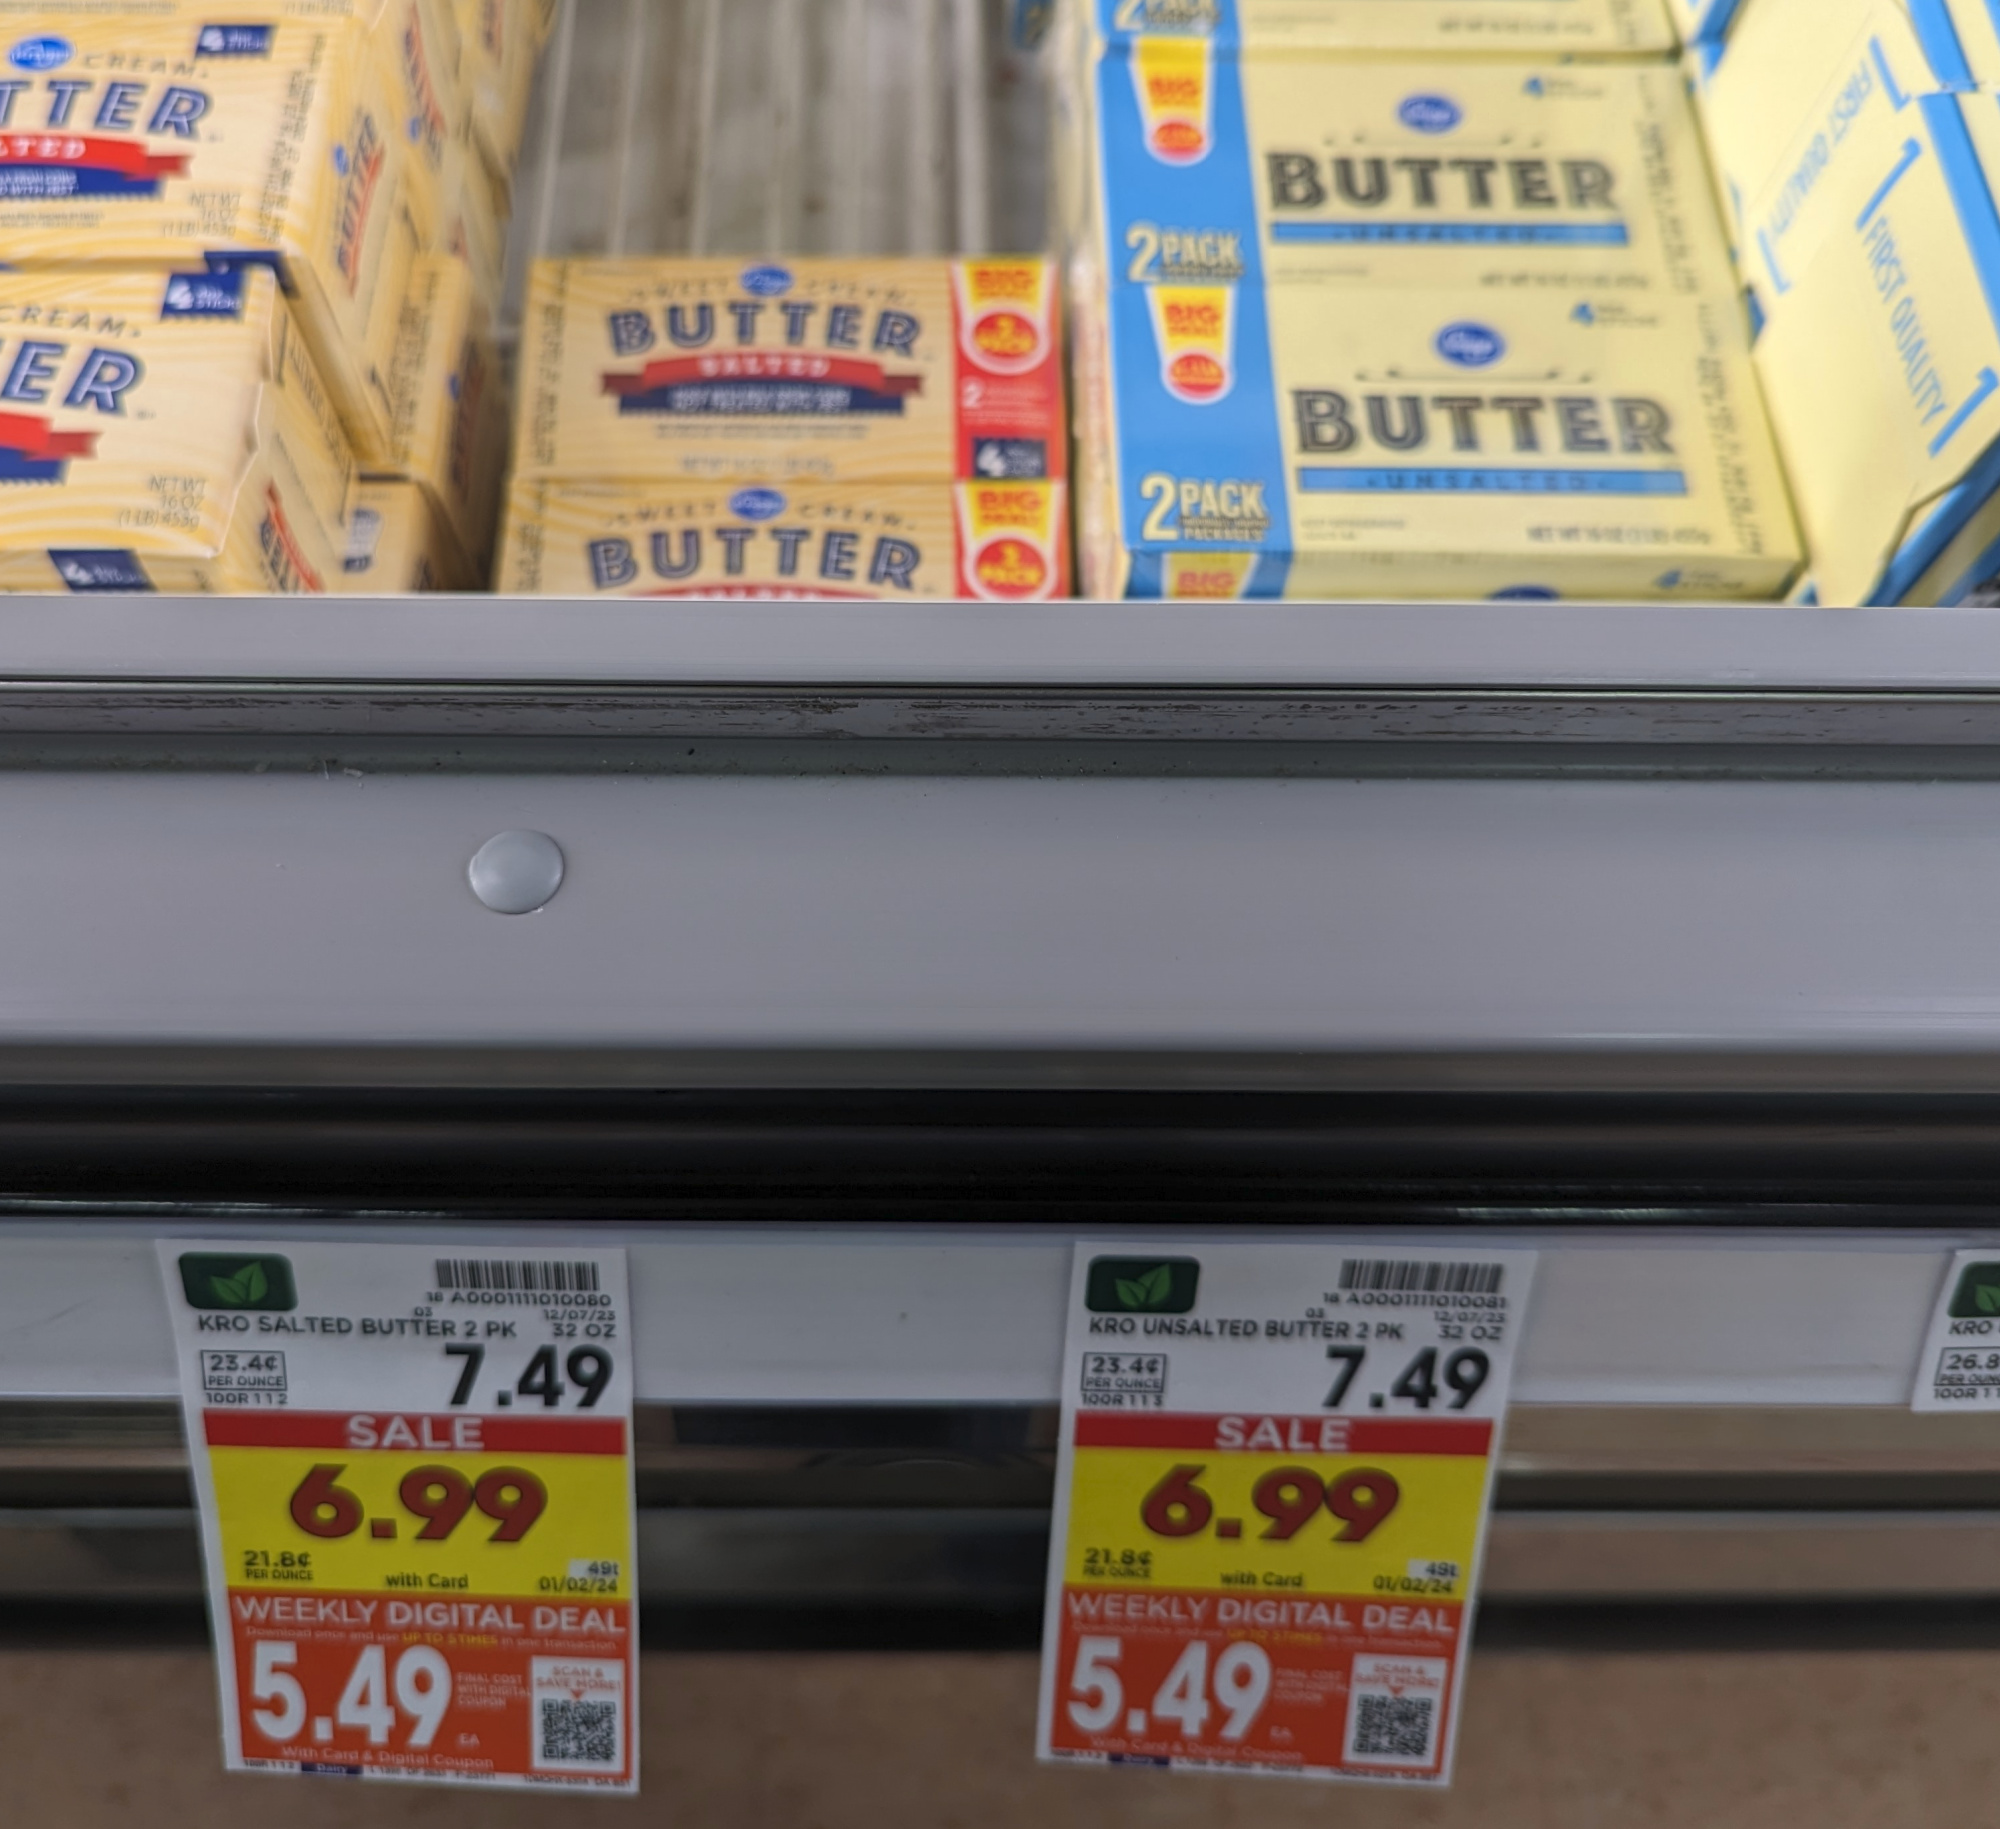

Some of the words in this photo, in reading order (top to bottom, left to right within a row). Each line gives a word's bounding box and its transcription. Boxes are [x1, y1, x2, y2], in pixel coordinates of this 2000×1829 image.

[0, 79, 209, 137] TTER
[1266, 151, 1619, 211] BUTTER
[1125, 222, 1160, 283] 2
[1162, 230, 1239, 265] PACK
[168, 277, 194, 311] 4
[609, 299, 920, 357] BUTTER
[1862, 215, 1907, 304] FIRST
[1890, 296, 1948, 427] QUALITY
[696, 355, 830, 378] SALTED
[1294, 388, 1676, 455] BUTTER
[149, 475, 179, 492] NET
[183, 477, 208, 494] WT
[1386, 473, 1589, 491] UNSALTED
[161, 494, 178, 508] 16
[181, 496, 206, 510] OZ
[978, 490, 1042, 512] BIG
[1140, 474, 1179, 541] 2
[1179, 481, 1267, 519] PACK
[587, 526, 922, 592] BUTTER
[1177, 570, 1237, 590] BIG
[413, 1306, 434, 1318] 03
[543, 1308, 617, 1322] 12/07/23
[198, 1315, 252, 1333] KRO
[259, 1316, 353, 1335] SALTED
[363, 1318, 457, 1337] BUTTER
[465, 1321, 478, 1337] 2
[486, 1322, 517, 1338] PK
[552, 1323, 578, 1338] 32
[586, 1323, 617, 1339] OZ
[1089, 1317, 1136, 1335] KRO
[1143, 1318, 1258, 1338] UNSALTED
[1265, 1320, 1350, 1339] BUTTER
[1356, 1322, 1369, 1339] 2
[1375, 1323, 1404, 1340] PK
[1437, 1324, 1463, 1340] 32
[1470, 1325, 1504, 1341] OZ
[1949, 1320, 1994, 1335] KRO
[210, 1354, 278, 1373] 23.4¢
[1091, 1356, 1160, 1375] 23.4¢
[208, 1375, 234, 1388] PER
[237, 1375, 284, 1388] OUNCE
[445, 1342, 615, 1409] 7.49
[1085, 1377, 1112, 1389] PER
[1115, 1377, 1162, 1390] OUNCE
[1322, 1344, 1491, 1410] 7.49
[1939, 1374, 1965, 1385] PER
[206, 1392, 249, 1406] 100R
[1081, 1394, 1125, 1407] 100R
[1933, 1387, 1977, 1400] 100R
[347, 1416, 485, 1449] SALE
[1215, 1417, 1351, 1450] SALE
[289, 1462, 549, 1543] 6.99
[1140, 1463, 1400, 1543] 6.99
[243, 1550, 311, 1568] 21.8¢
[1084, 1548, 1153, 1566] 21.8¢
[245, 1568, 270, 1581] PER
[272, 1569, 314, 1582] OUNCE
[385, 1572, 425, 1589] with
[428, 1572, 470, 1589] Card
[1221, 1570, 1259, 1587] with
[1262, 1572, 1304, 1588] Card
[539, 1576, 619, 1594] 01/02/24
[1374, 1576, 1454, 1594] 01/02/24
[234, 1596, 379, 1624] WEEKLY
[387, 1601, 525, 1629] DIGITAL
[534, 1606, 626, 1633] DEAL
[1067, 1592, 1208, 1620] WEEKLY
[1216, 1598, 1352, 1628] DIGITAL
[1362, 1605, 1454, 1633] DEAL
[401, 1632, 422, 1644] UP
[424, 1633, 445, 1645] TO
[459, 1634, 498, 1646] TIMES
[456, 1672, 490, 1684] FINAL
[493, 1674, 523, 1686] COST
[552, 1666, 592, 1677] SCAN
[456, 1684, 487, 1696] WITH
[536, 1676, 573, 1688] SAVE
[1067, 1635, 1272, 1742] 5.49
[251, 1640, 454, 1749] 5.49
[459, 1733, 480, 1747] EA
[1092, 1734, 1126, 1750] With
[1133, 1738, 1169, 1754] Card
[1187, 1741, 1239, 1760] Digital
[1243, 1746, 1304, 1764] Coupon
[281, 1745, 320, 1760] With
[322, 1747, 361, 1763] Card
[363, 1749, 374, 1763] &
[378, 1750, 431, 1768] Digital
[433, 1754, 496, 1772] Coupon
